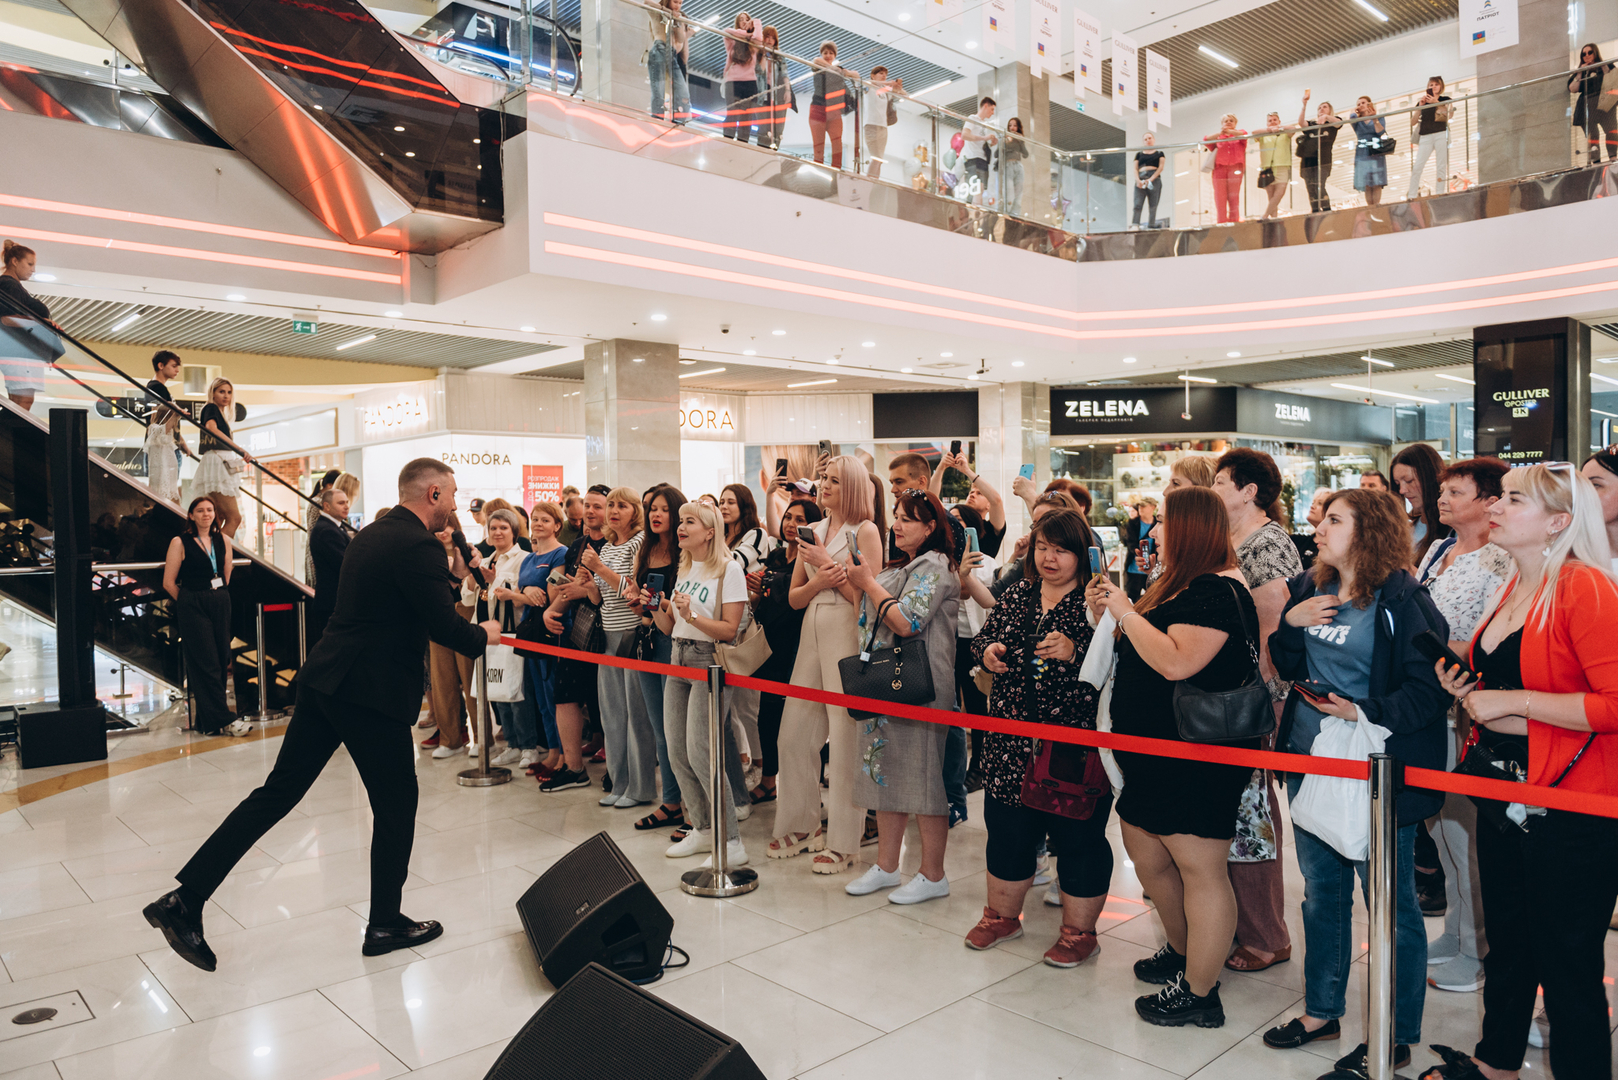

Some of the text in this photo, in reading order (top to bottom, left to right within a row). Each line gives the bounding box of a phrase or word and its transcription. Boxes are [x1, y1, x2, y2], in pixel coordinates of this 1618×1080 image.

[1493, 388, 1550, 401] GULLIVER
[1064, 399, 1150, 418] ZELENA
[1274, 403, 1311, 422] ZELENA
[1512, 451, 1525, 459] 229
[1526, 450, 1543, 458] 7777
[527, 482, 560, 490] ЗНИЖКИ
[535, 490, 560, 502] 50%
[672, 580, 709, 603] OHO
[1304, 623, 1351, 645] evi's
